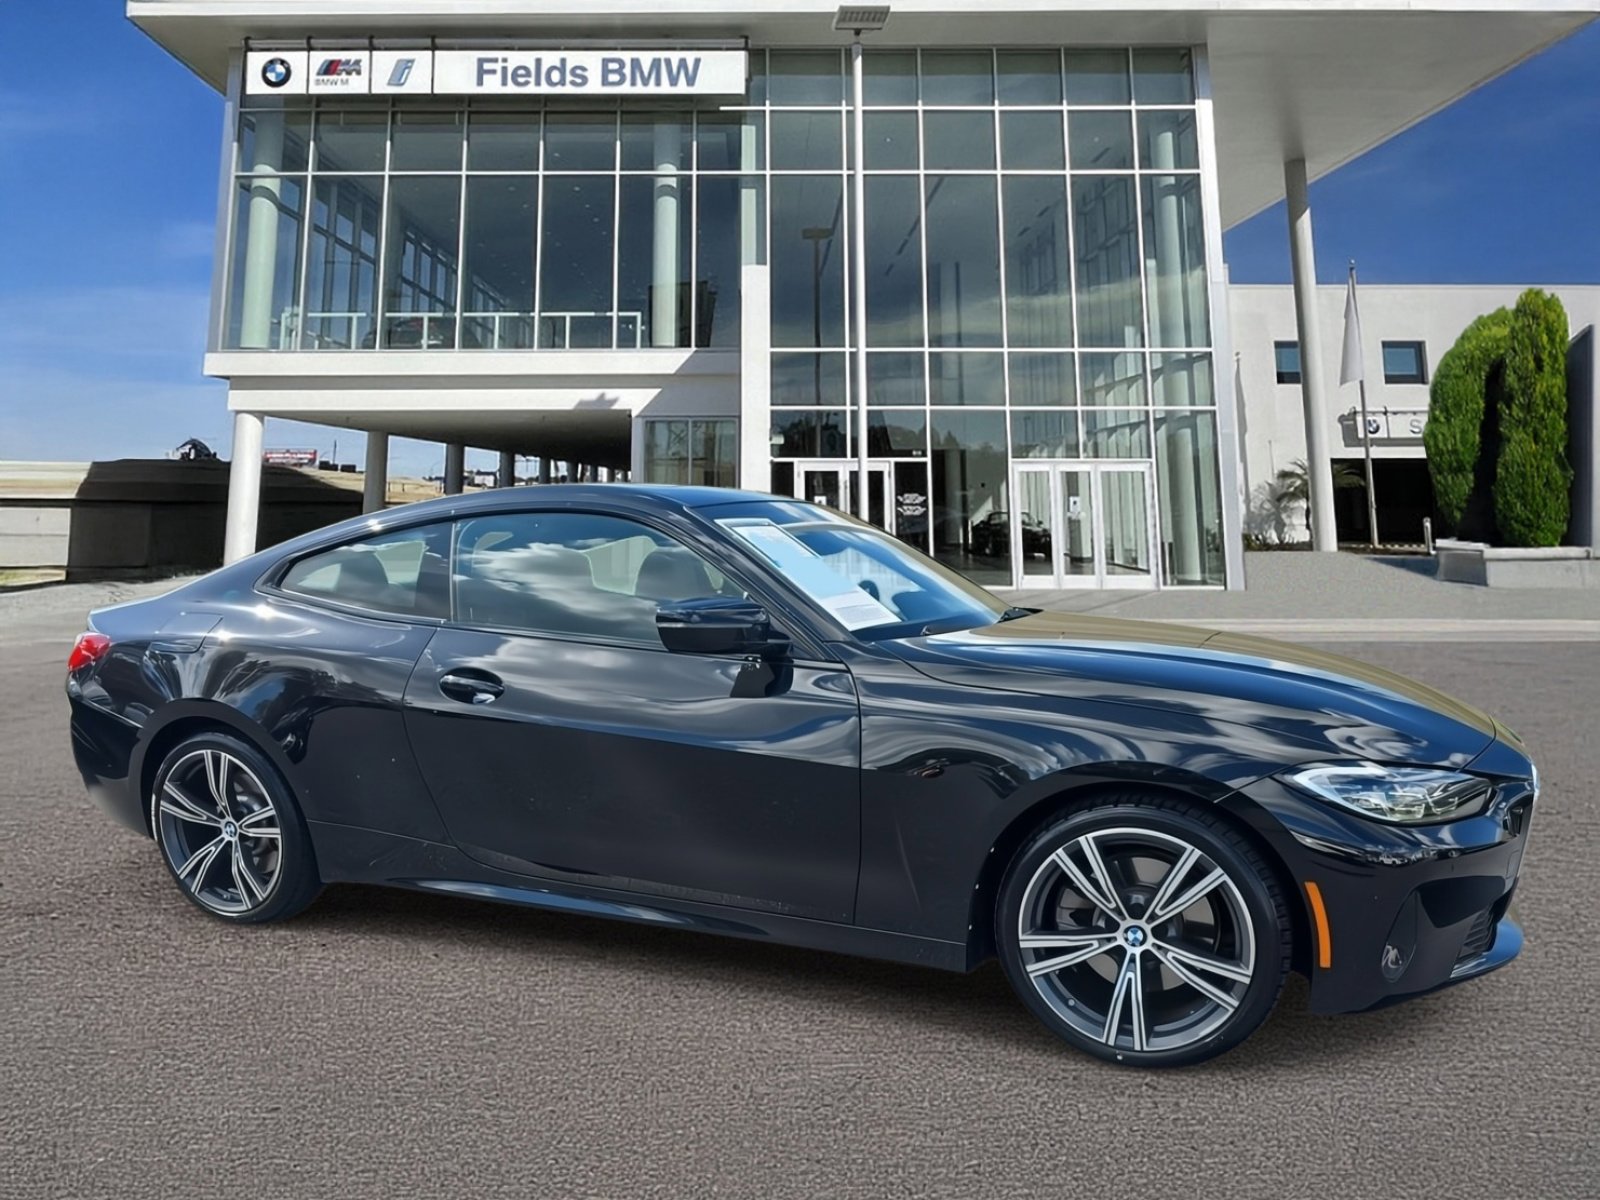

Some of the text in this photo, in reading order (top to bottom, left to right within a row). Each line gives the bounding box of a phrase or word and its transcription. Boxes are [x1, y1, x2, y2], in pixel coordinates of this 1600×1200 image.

[476, 57, 702, 87] Fields BMW
[314, 78, 338, 86] BMW
